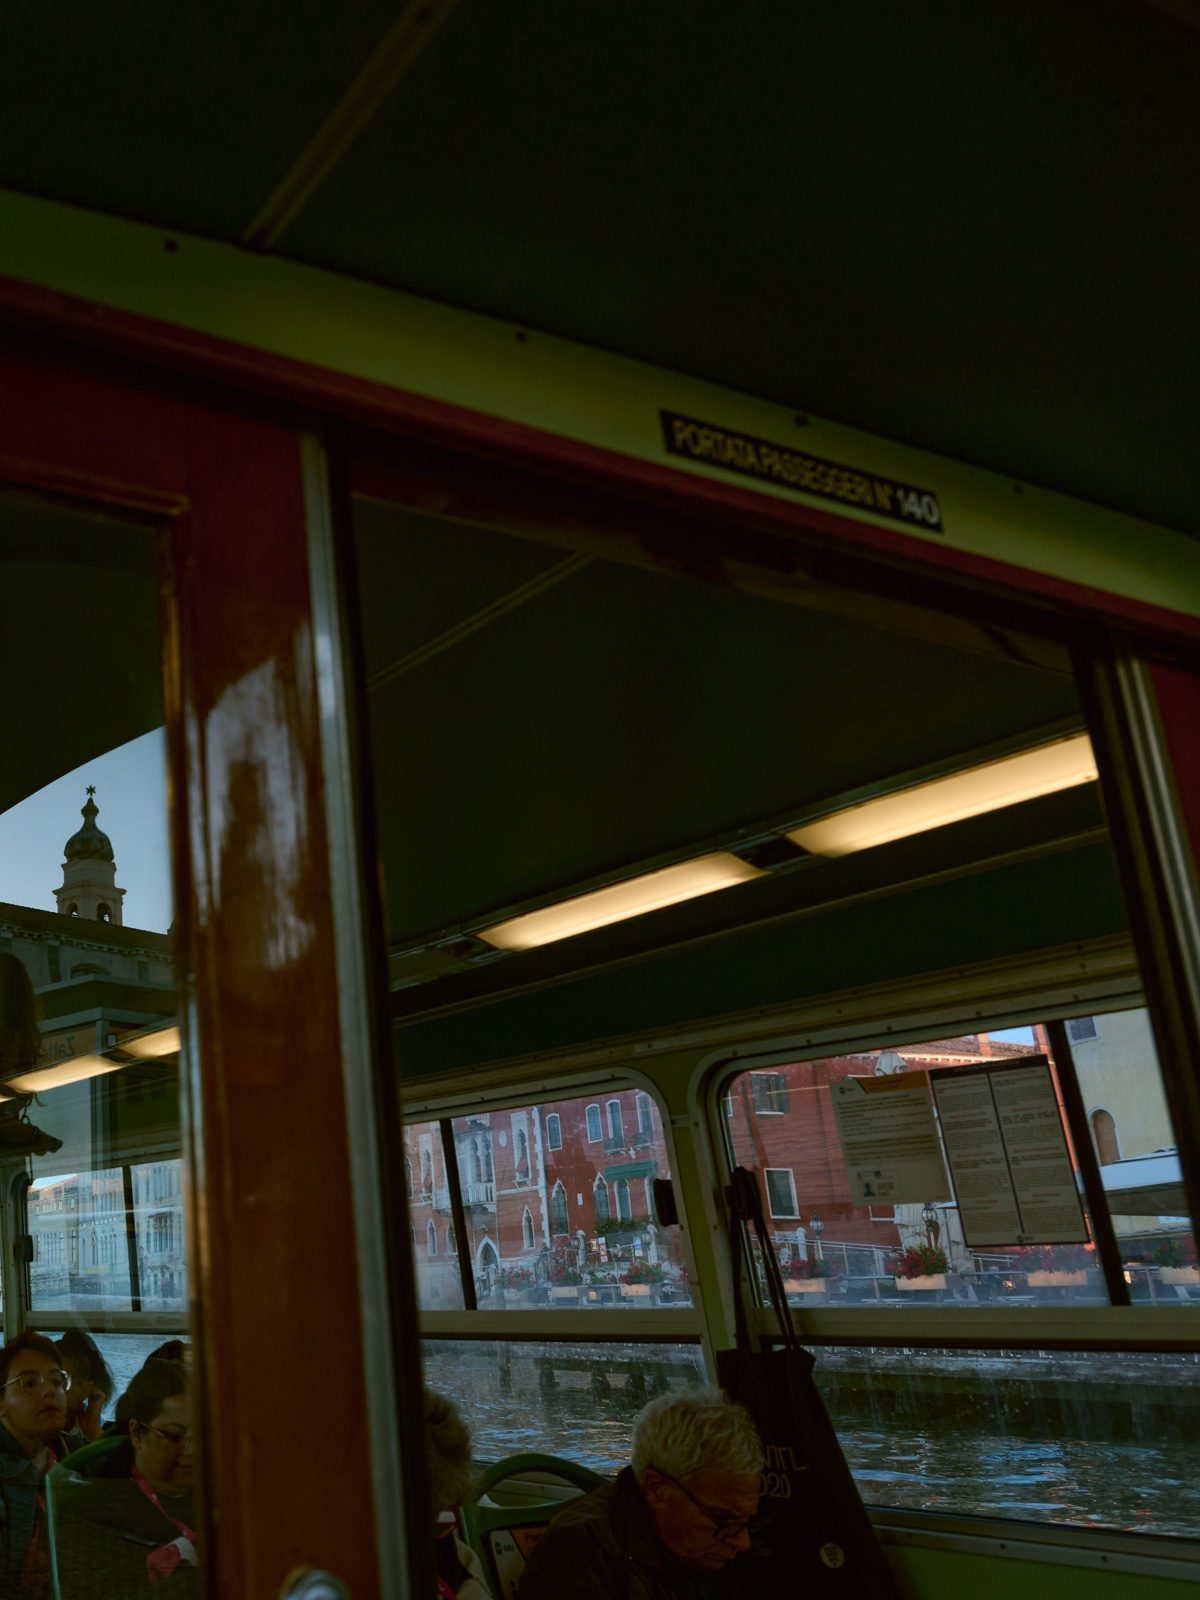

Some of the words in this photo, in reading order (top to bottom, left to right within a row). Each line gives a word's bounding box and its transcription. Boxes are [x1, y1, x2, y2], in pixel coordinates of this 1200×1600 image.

[673, 419, 761, 471] PORTATA
[759, 444, 874, 506] PASSEGGERI
[895, 487, 941, 525] 140
